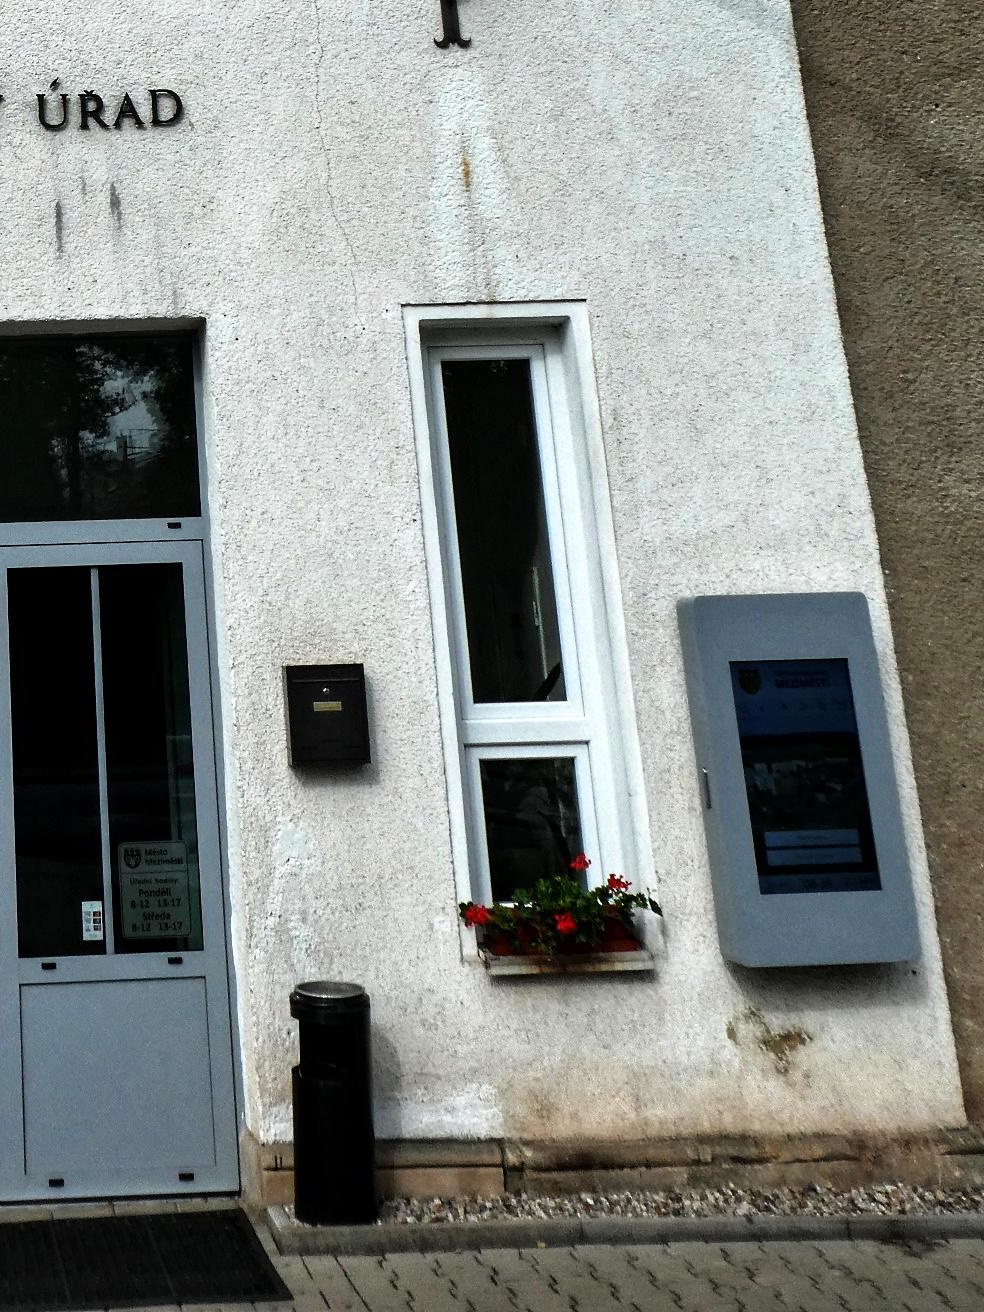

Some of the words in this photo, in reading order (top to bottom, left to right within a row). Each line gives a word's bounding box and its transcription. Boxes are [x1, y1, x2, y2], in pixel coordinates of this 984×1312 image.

[36, 76, 184, 131] ÚŘAD
[138, 887, 171, 898] Pondělí
[142, 911, 171, 921] Středa
